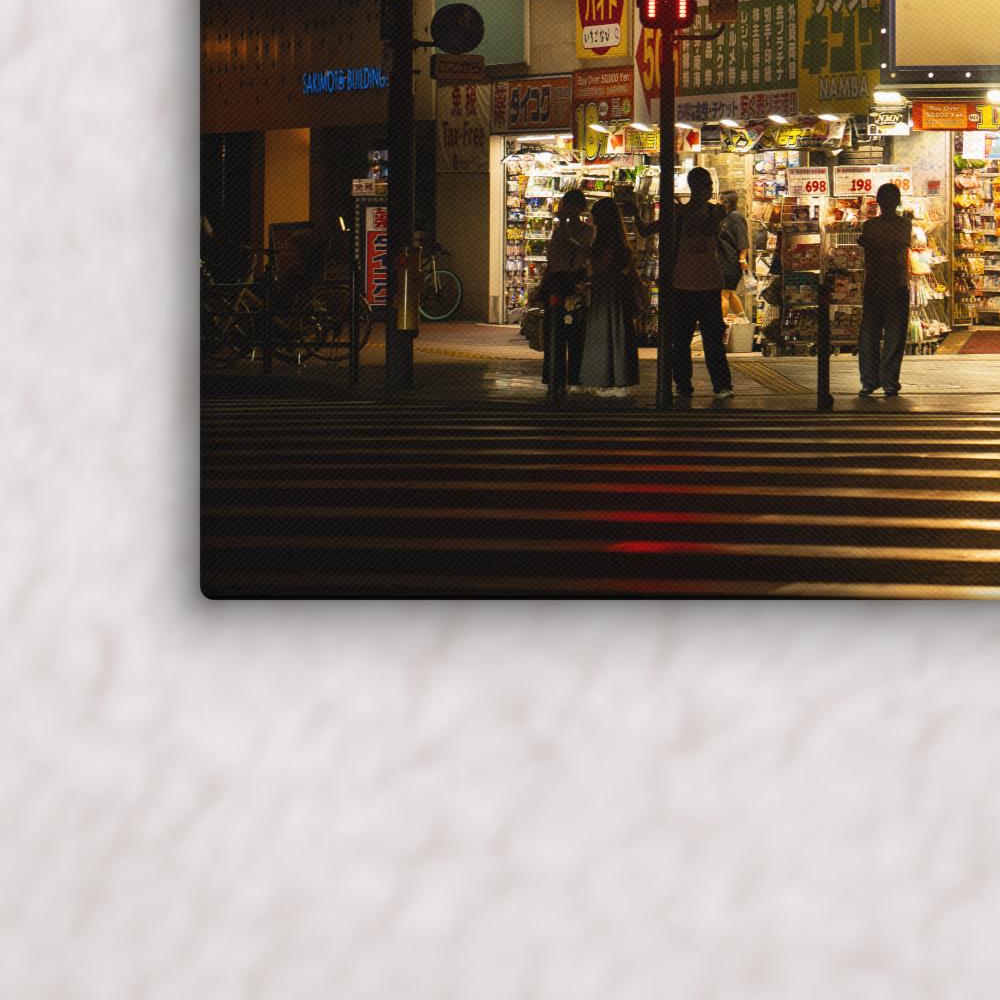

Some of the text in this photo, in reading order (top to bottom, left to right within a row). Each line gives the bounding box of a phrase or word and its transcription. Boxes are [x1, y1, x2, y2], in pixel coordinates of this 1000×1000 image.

[819, 76, 868, 102] NAMBA
[805, 180, 827, 193] 698
[851, 178, 873, 192] 198
